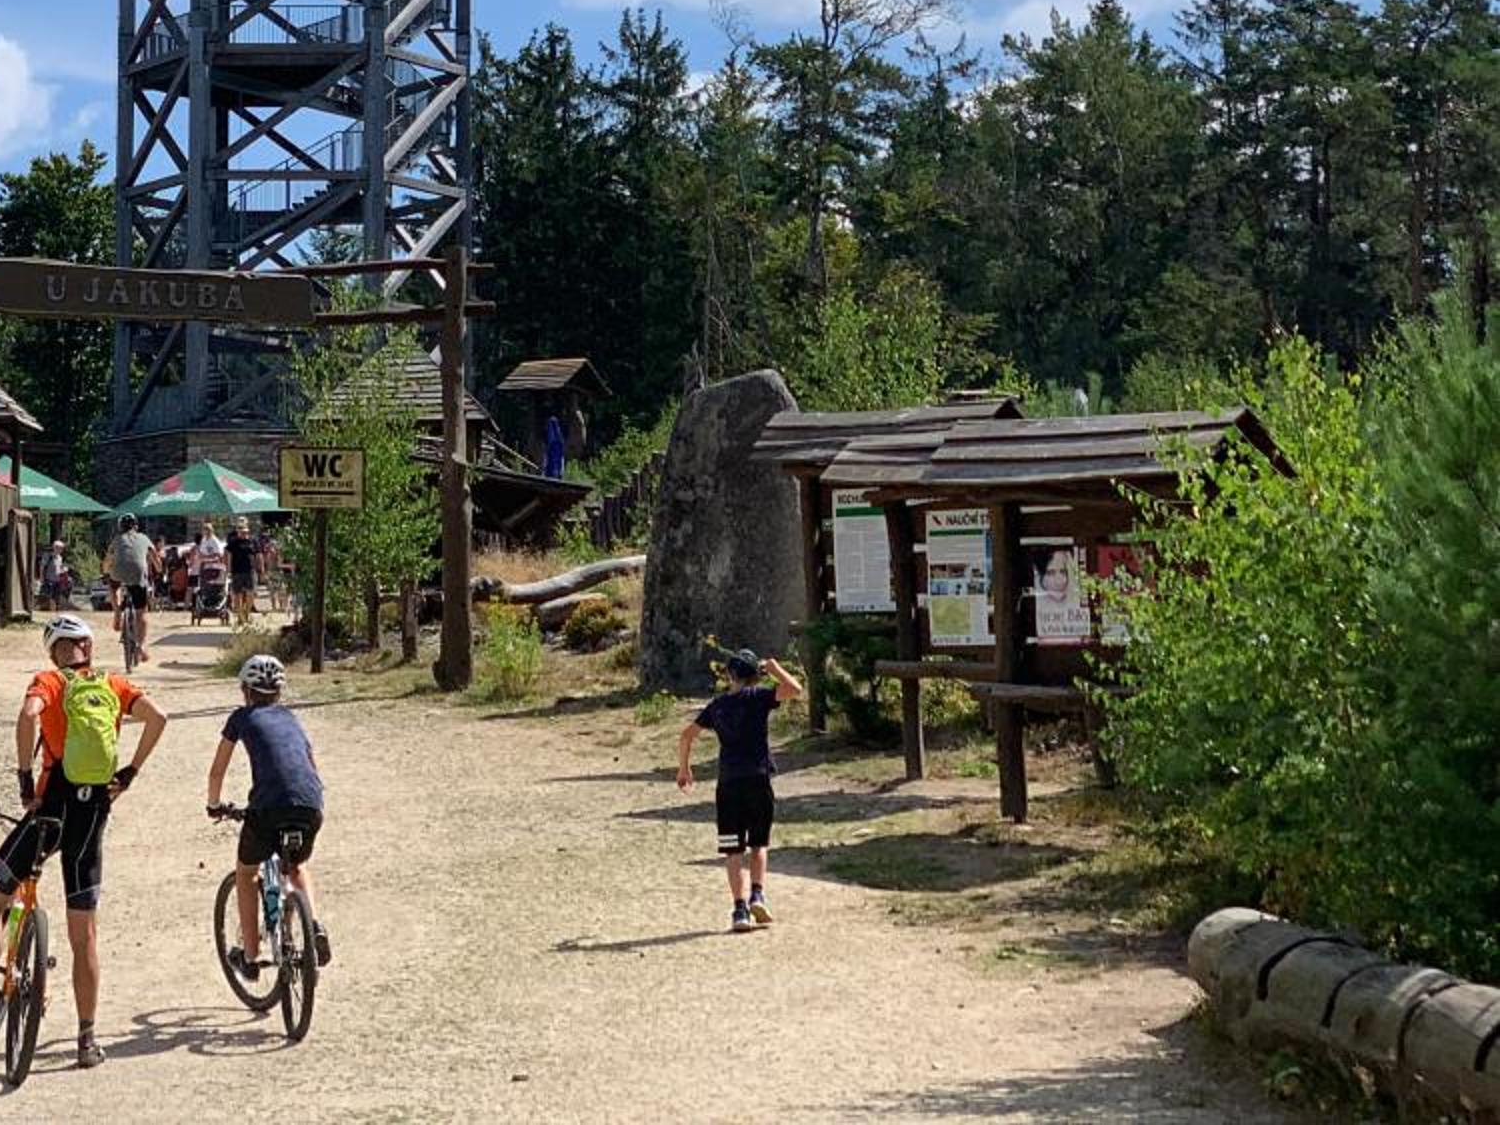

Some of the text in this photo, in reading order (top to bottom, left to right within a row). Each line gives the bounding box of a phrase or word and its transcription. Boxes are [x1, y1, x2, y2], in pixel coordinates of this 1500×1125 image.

[46, 275, 245, 310] U JAKUBA
[303, 453, 343, 478] WC
